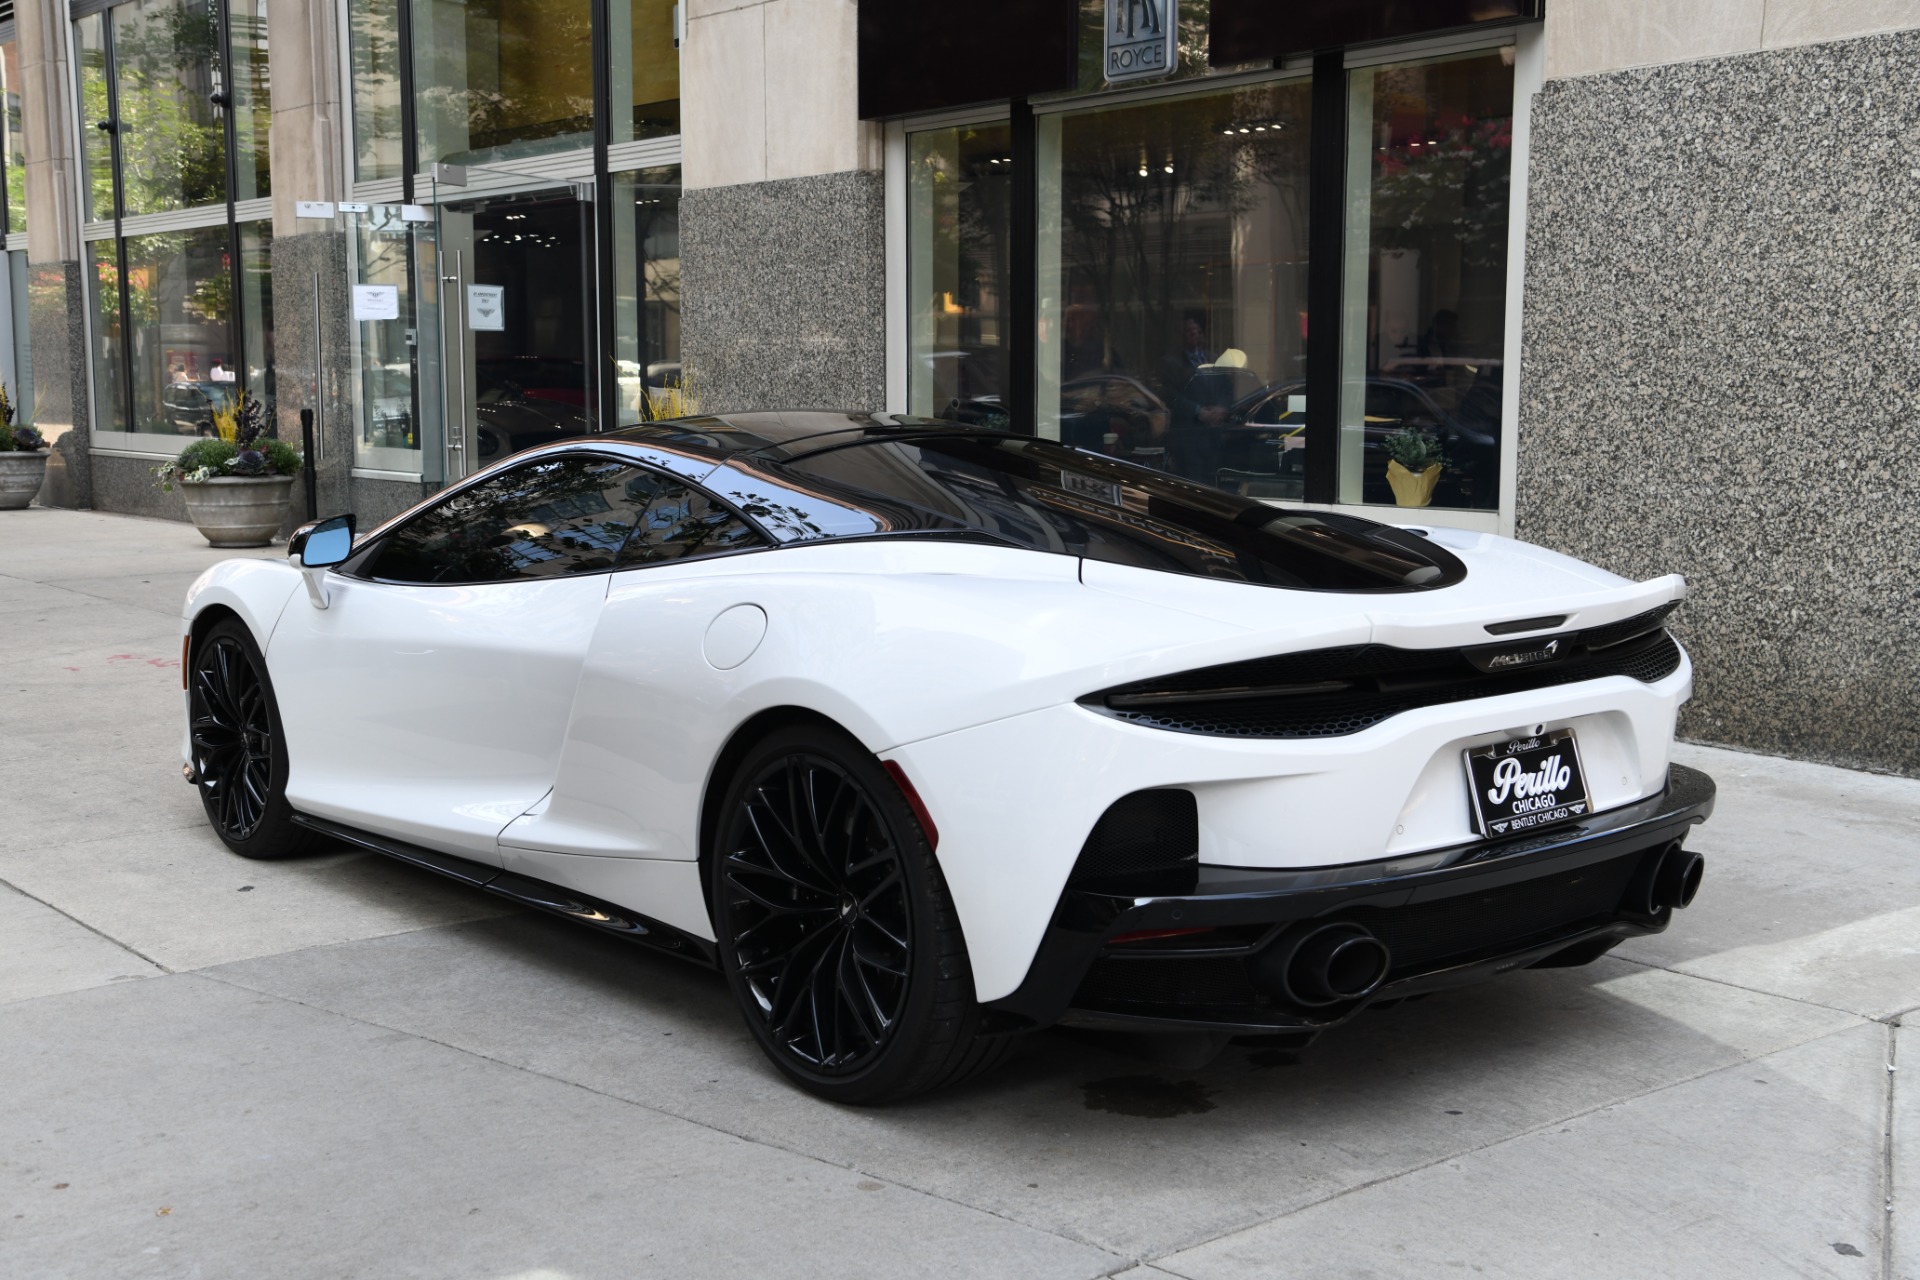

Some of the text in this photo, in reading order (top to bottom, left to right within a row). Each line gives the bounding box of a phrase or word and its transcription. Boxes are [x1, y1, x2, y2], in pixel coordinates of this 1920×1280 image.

[1111, 44, 1162, 70] ROYCE
[1506, 737, 1541, 755] Perillo
[1488, 754, 1571, 805] Perillo
[1512, 793, 1556, 814] CHICAGO
[1511, 807, 1569, 830] BENTLEY CHICAGO
